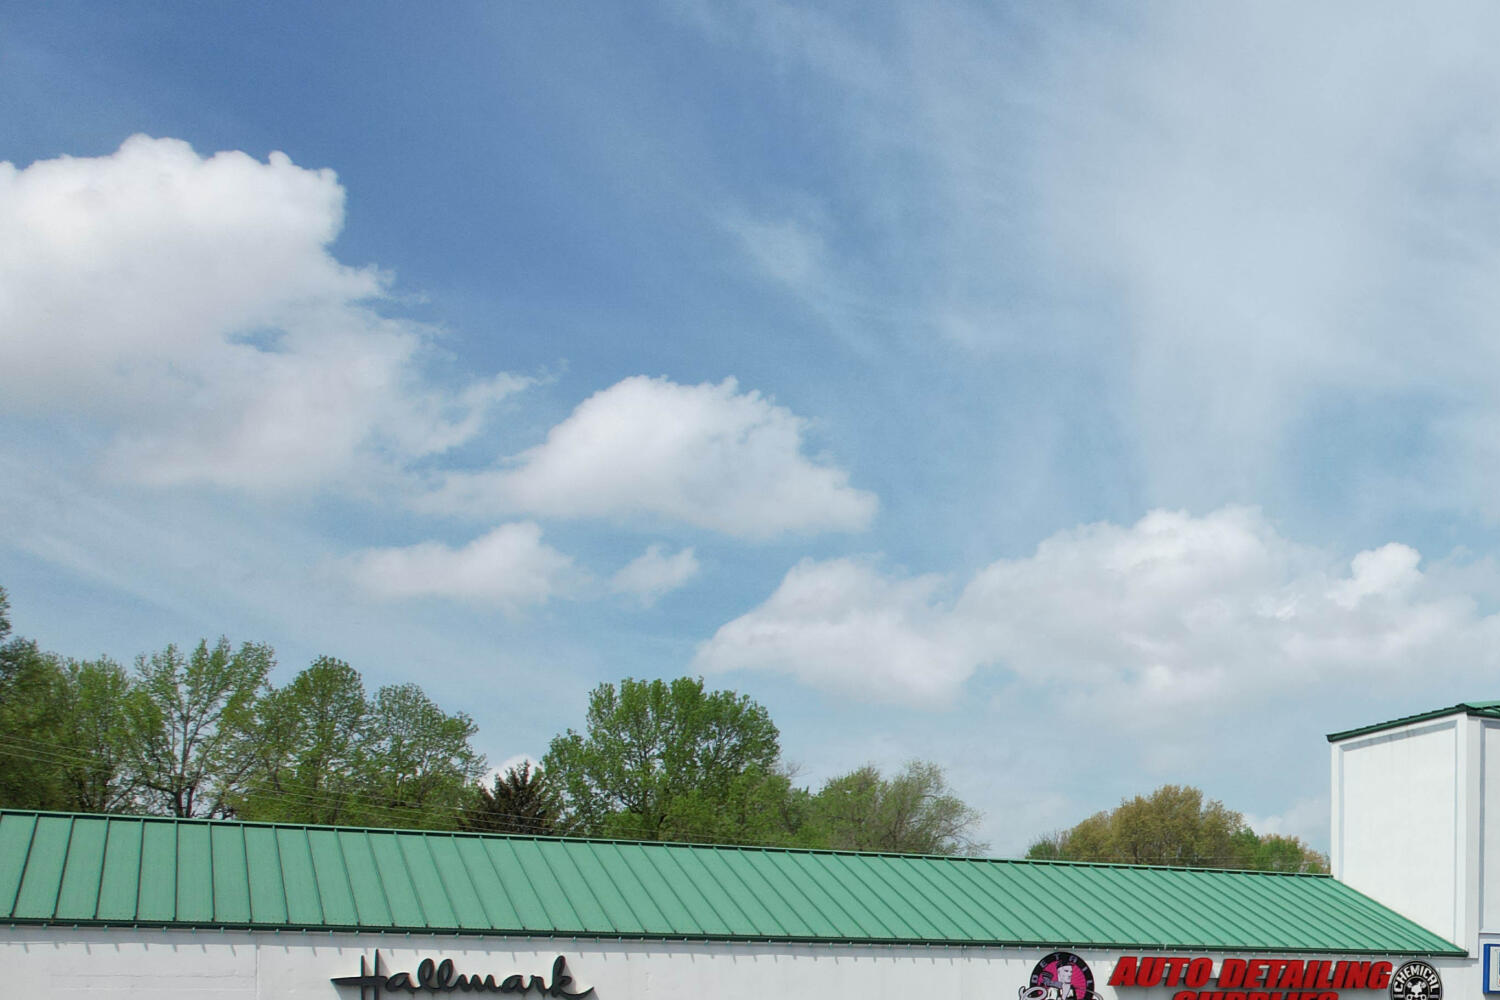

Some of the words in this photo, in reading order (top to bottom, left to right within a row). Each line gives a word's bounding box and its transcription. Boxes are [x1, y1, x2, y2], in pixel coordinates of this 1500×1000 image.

[1030, 953, 1094, 987] DETAIL
[1107, 956, 1214, 988] AUTO
[1216, 958, 1393, 990] DETAILING
[1393, 964, 1440, 993] CHEMICAL
